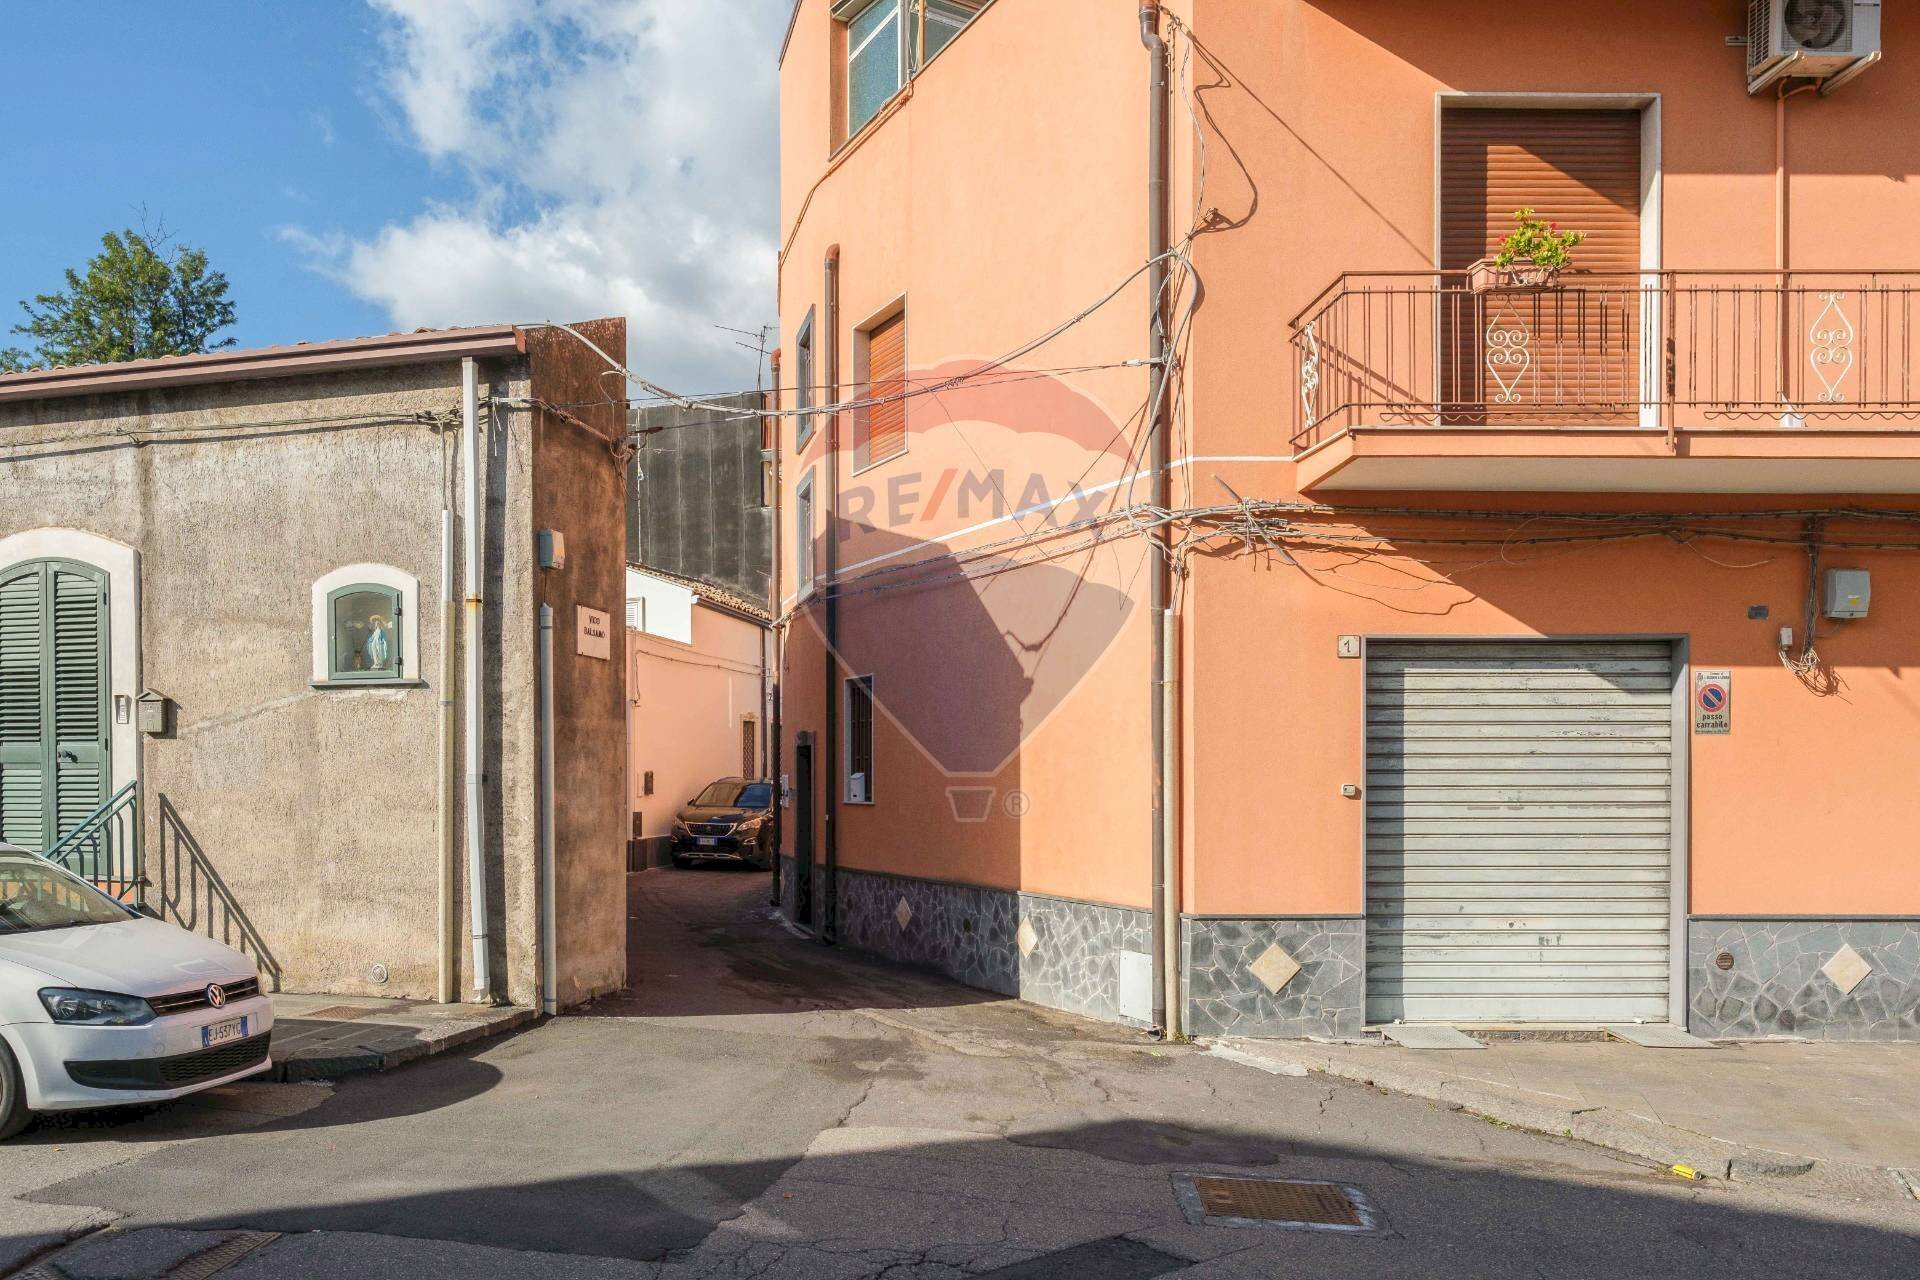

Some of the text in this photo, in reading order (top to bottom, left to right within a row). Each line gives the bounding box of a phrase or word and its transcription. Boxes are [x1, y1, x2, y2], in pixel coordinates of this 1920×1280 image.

[589, 615, 601, 625] VICO
[1344, 640, 1351, 653] 1
[1696, 720, 1728, 729] carrabile
